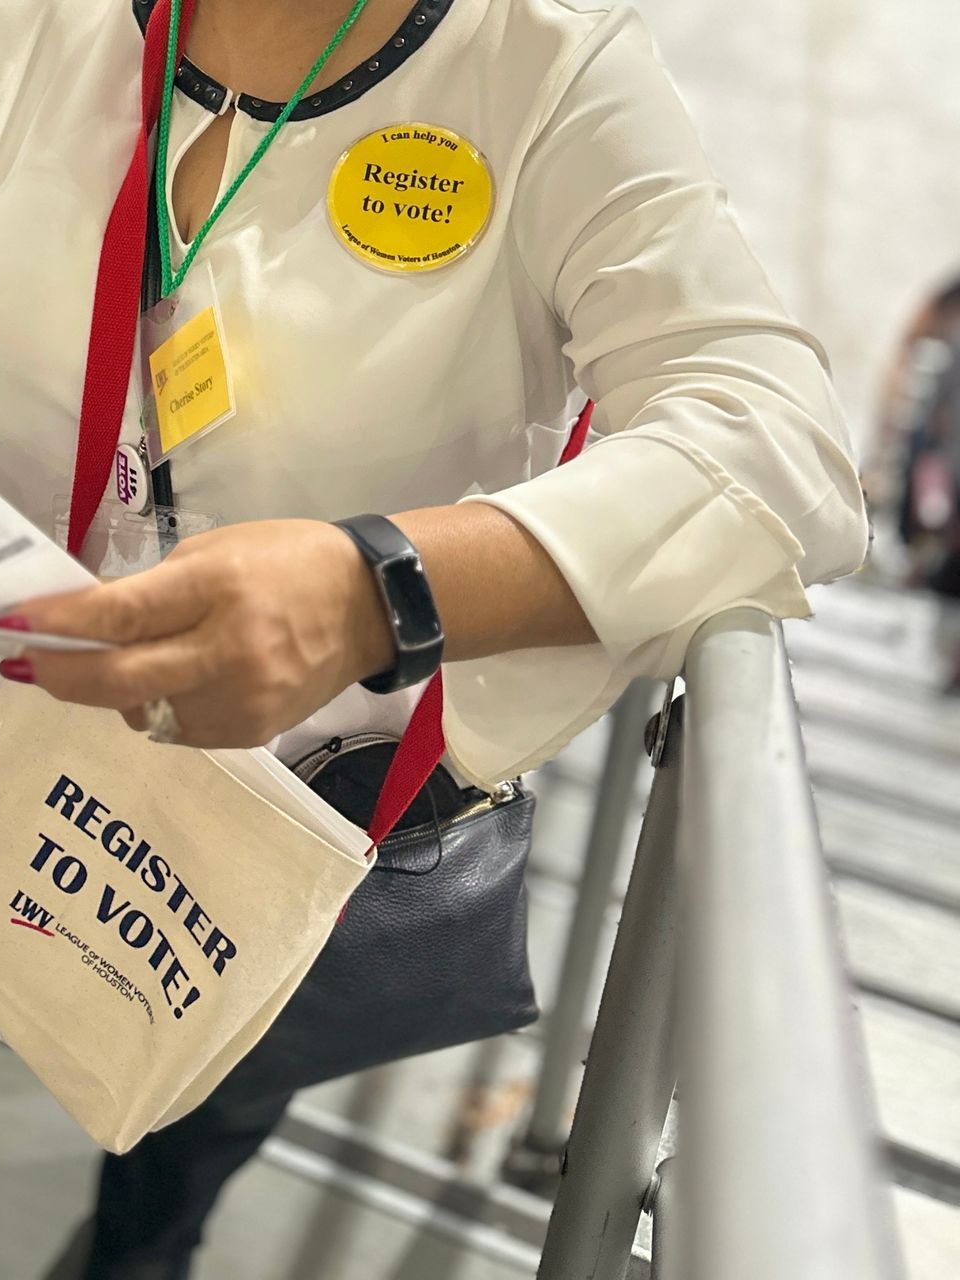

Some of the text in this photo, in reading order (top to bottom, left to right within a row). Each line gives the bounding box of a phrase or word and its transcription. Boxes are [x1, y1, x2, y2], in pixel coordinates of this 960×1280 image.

[381, 130, 458, 152] I can help you
[363, 162, 465, 193] Register
[362, 195, 453, 224] to vote!
[342, 224, 461, 263] League of Women Voters of Houston
[169, 389, 195, 414] Cherise
[118, 454, 126, 499] VOTE
[44, 773, 238, 977] REGISTER
[8, 889, 55, 929] LWV
[29, 832, 201, 1020] TO VOTE!
[55, 922, 90, 953] LEAGUE
[88, 950, 100, 961] OF
[99, 957, 134, 990] WOMEN
[81, 954, 135, 1002] OF HOUSTON
